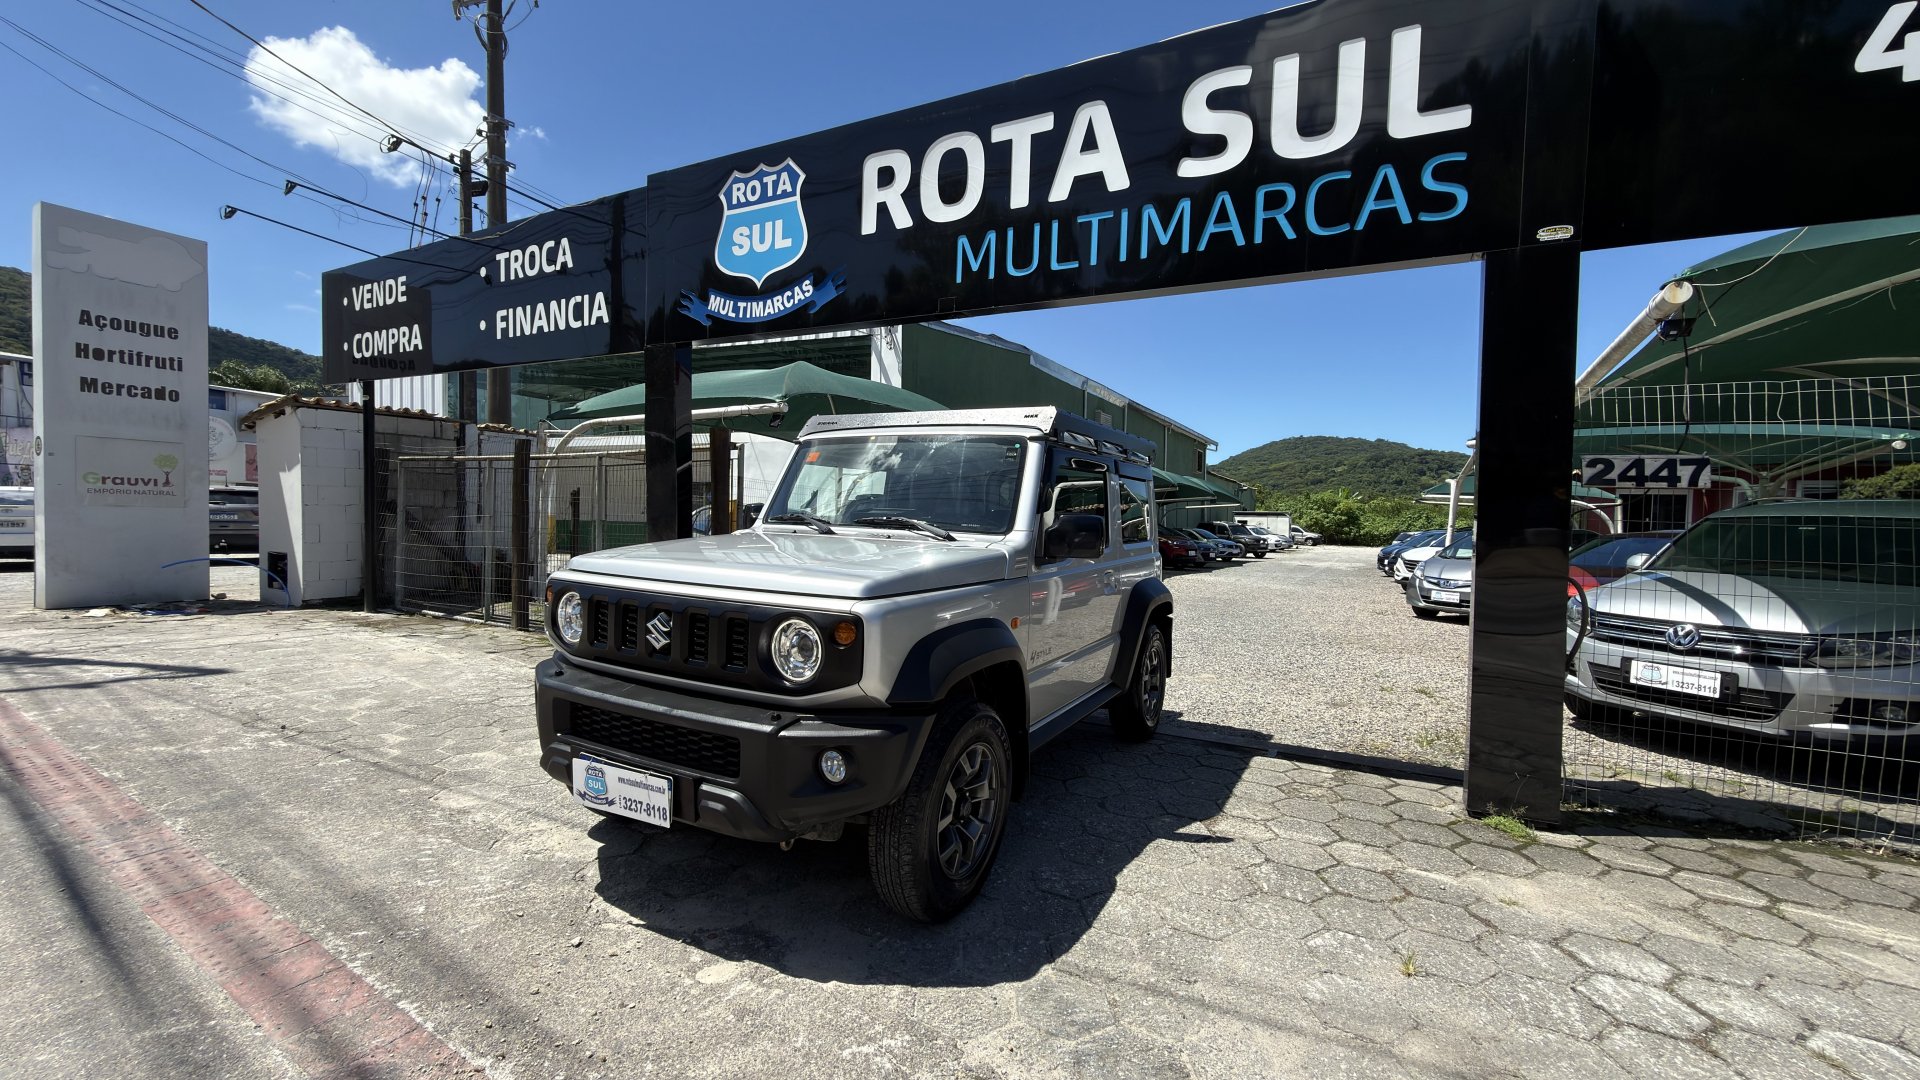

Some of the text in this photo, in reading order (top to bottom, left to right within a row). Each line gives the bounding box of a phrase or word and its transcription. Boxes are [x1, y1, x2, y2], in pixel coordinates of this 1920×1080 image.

[860, 23, 1473, 237] ROTA SUL
[731, 171, 793, 205] ROTA
[954, 151, 1469, 285] MULTIMARCAS
[731, 218, 793, 257] SUL
[495, 237, 574, 283] TROCA
[352, 275, 408, 312] VENDE
[707, 279, 814, 319] MULTIMARCAS
[78, 309, 180, 341] Açougue
[496, 291, 610, 340] FINANCIA
[75, 341, 184, 372] Hortifruti
[352, 323, 424, 360] COMPRA
[79, 376, 181, 403] Mercado
[1584, 457, 1711, 488] 2447
[133, 489, 177, 497] NATURAL
[588, 779, 604, 790] SUL
[623, 797, 668, 821] 3237-8118
